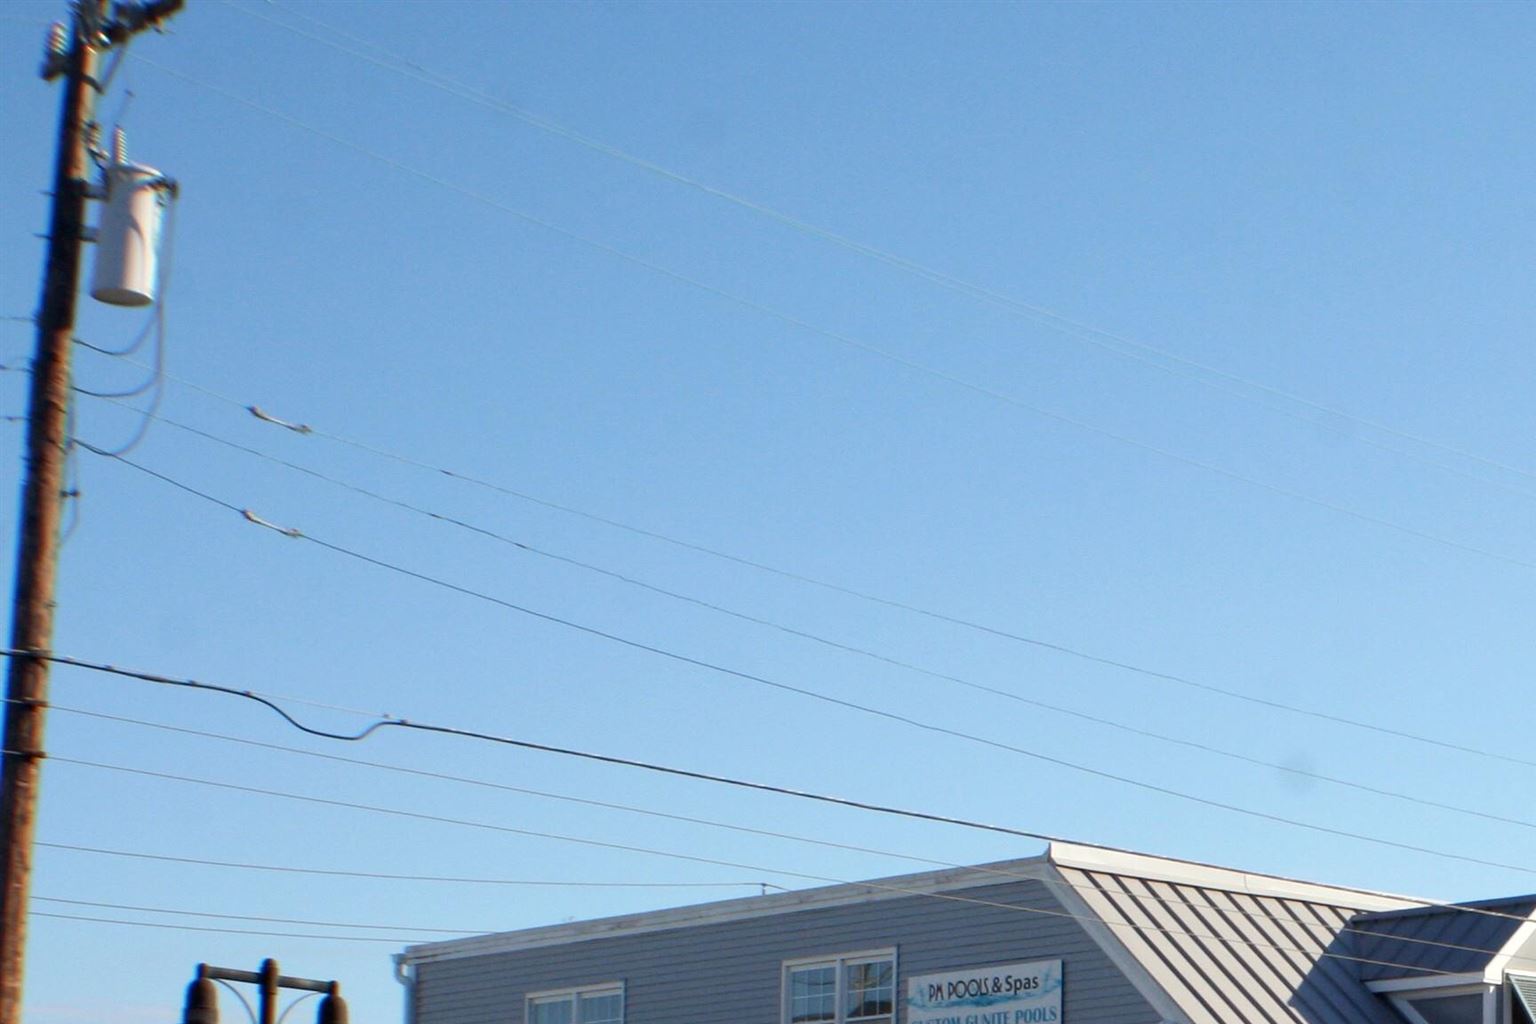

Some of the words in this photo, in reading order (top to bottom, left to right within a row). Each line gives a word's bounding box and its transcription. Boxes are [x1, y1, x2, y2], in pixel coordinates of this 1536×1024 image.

[929, 983, 944, 1001] PM
[948, 977, 989, 998] POOLS
[991, 976, 1003, 994] &
[1005, 975, 1039, 996] Spas
